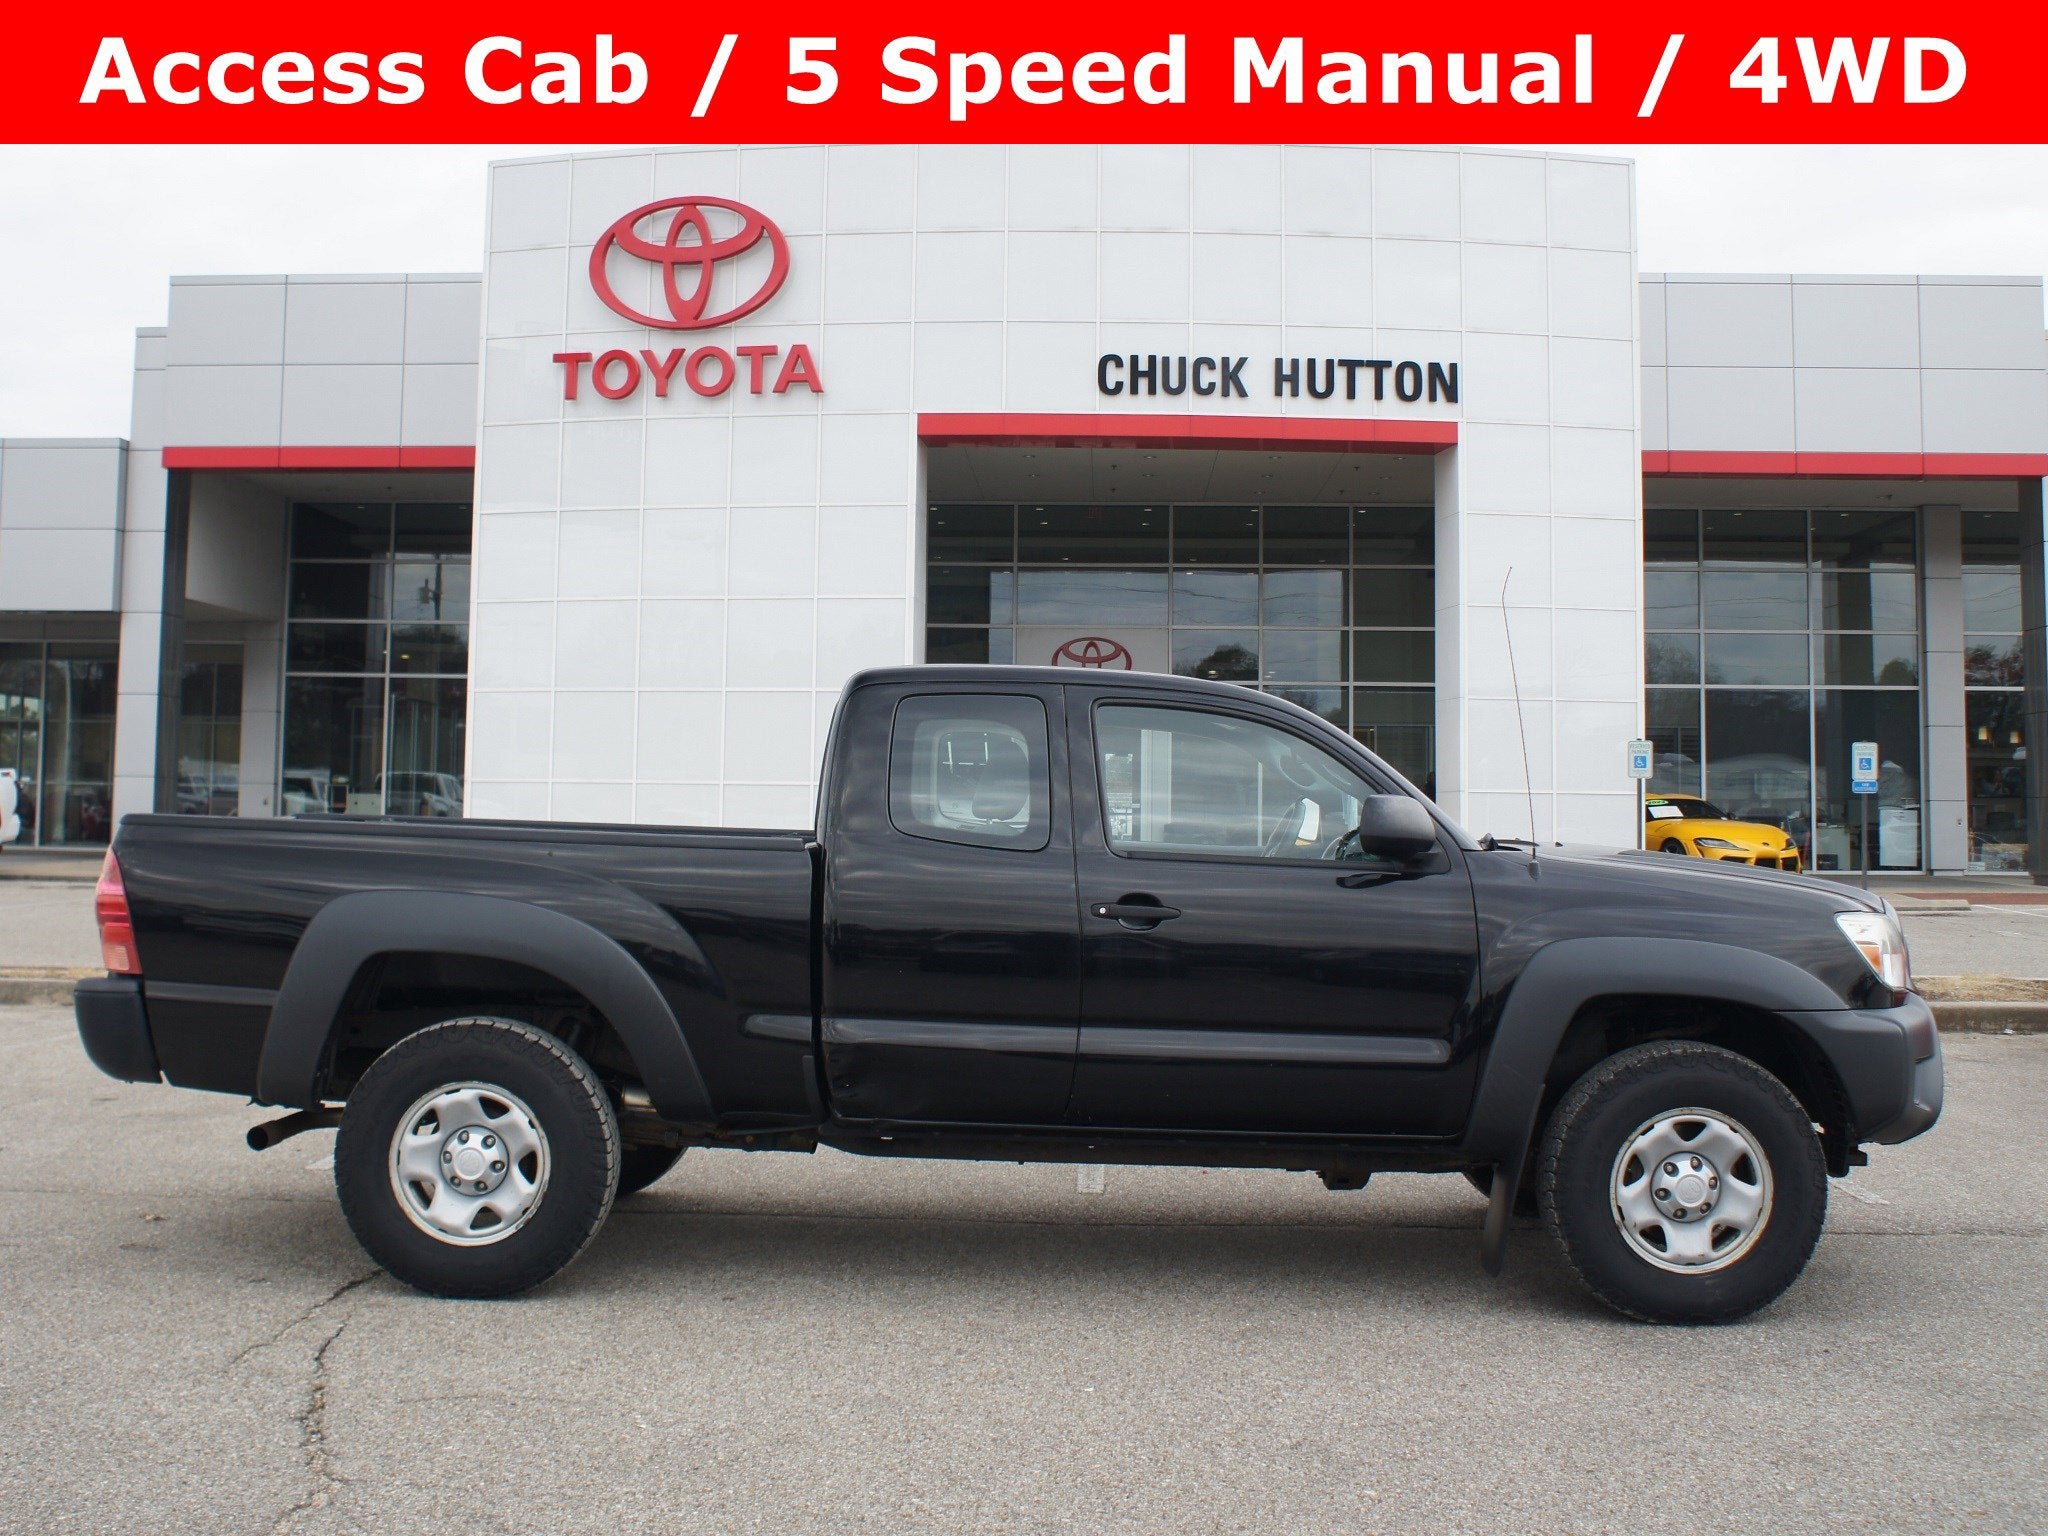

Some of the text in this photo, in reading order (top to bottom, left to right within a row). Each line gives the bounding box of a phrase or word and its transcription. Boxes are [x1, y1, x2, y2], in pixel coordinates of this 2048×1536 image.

[553, 344, 823, 401] TOYOTA
[1097, 354, 1458, 404] CHUCK HUTTON
